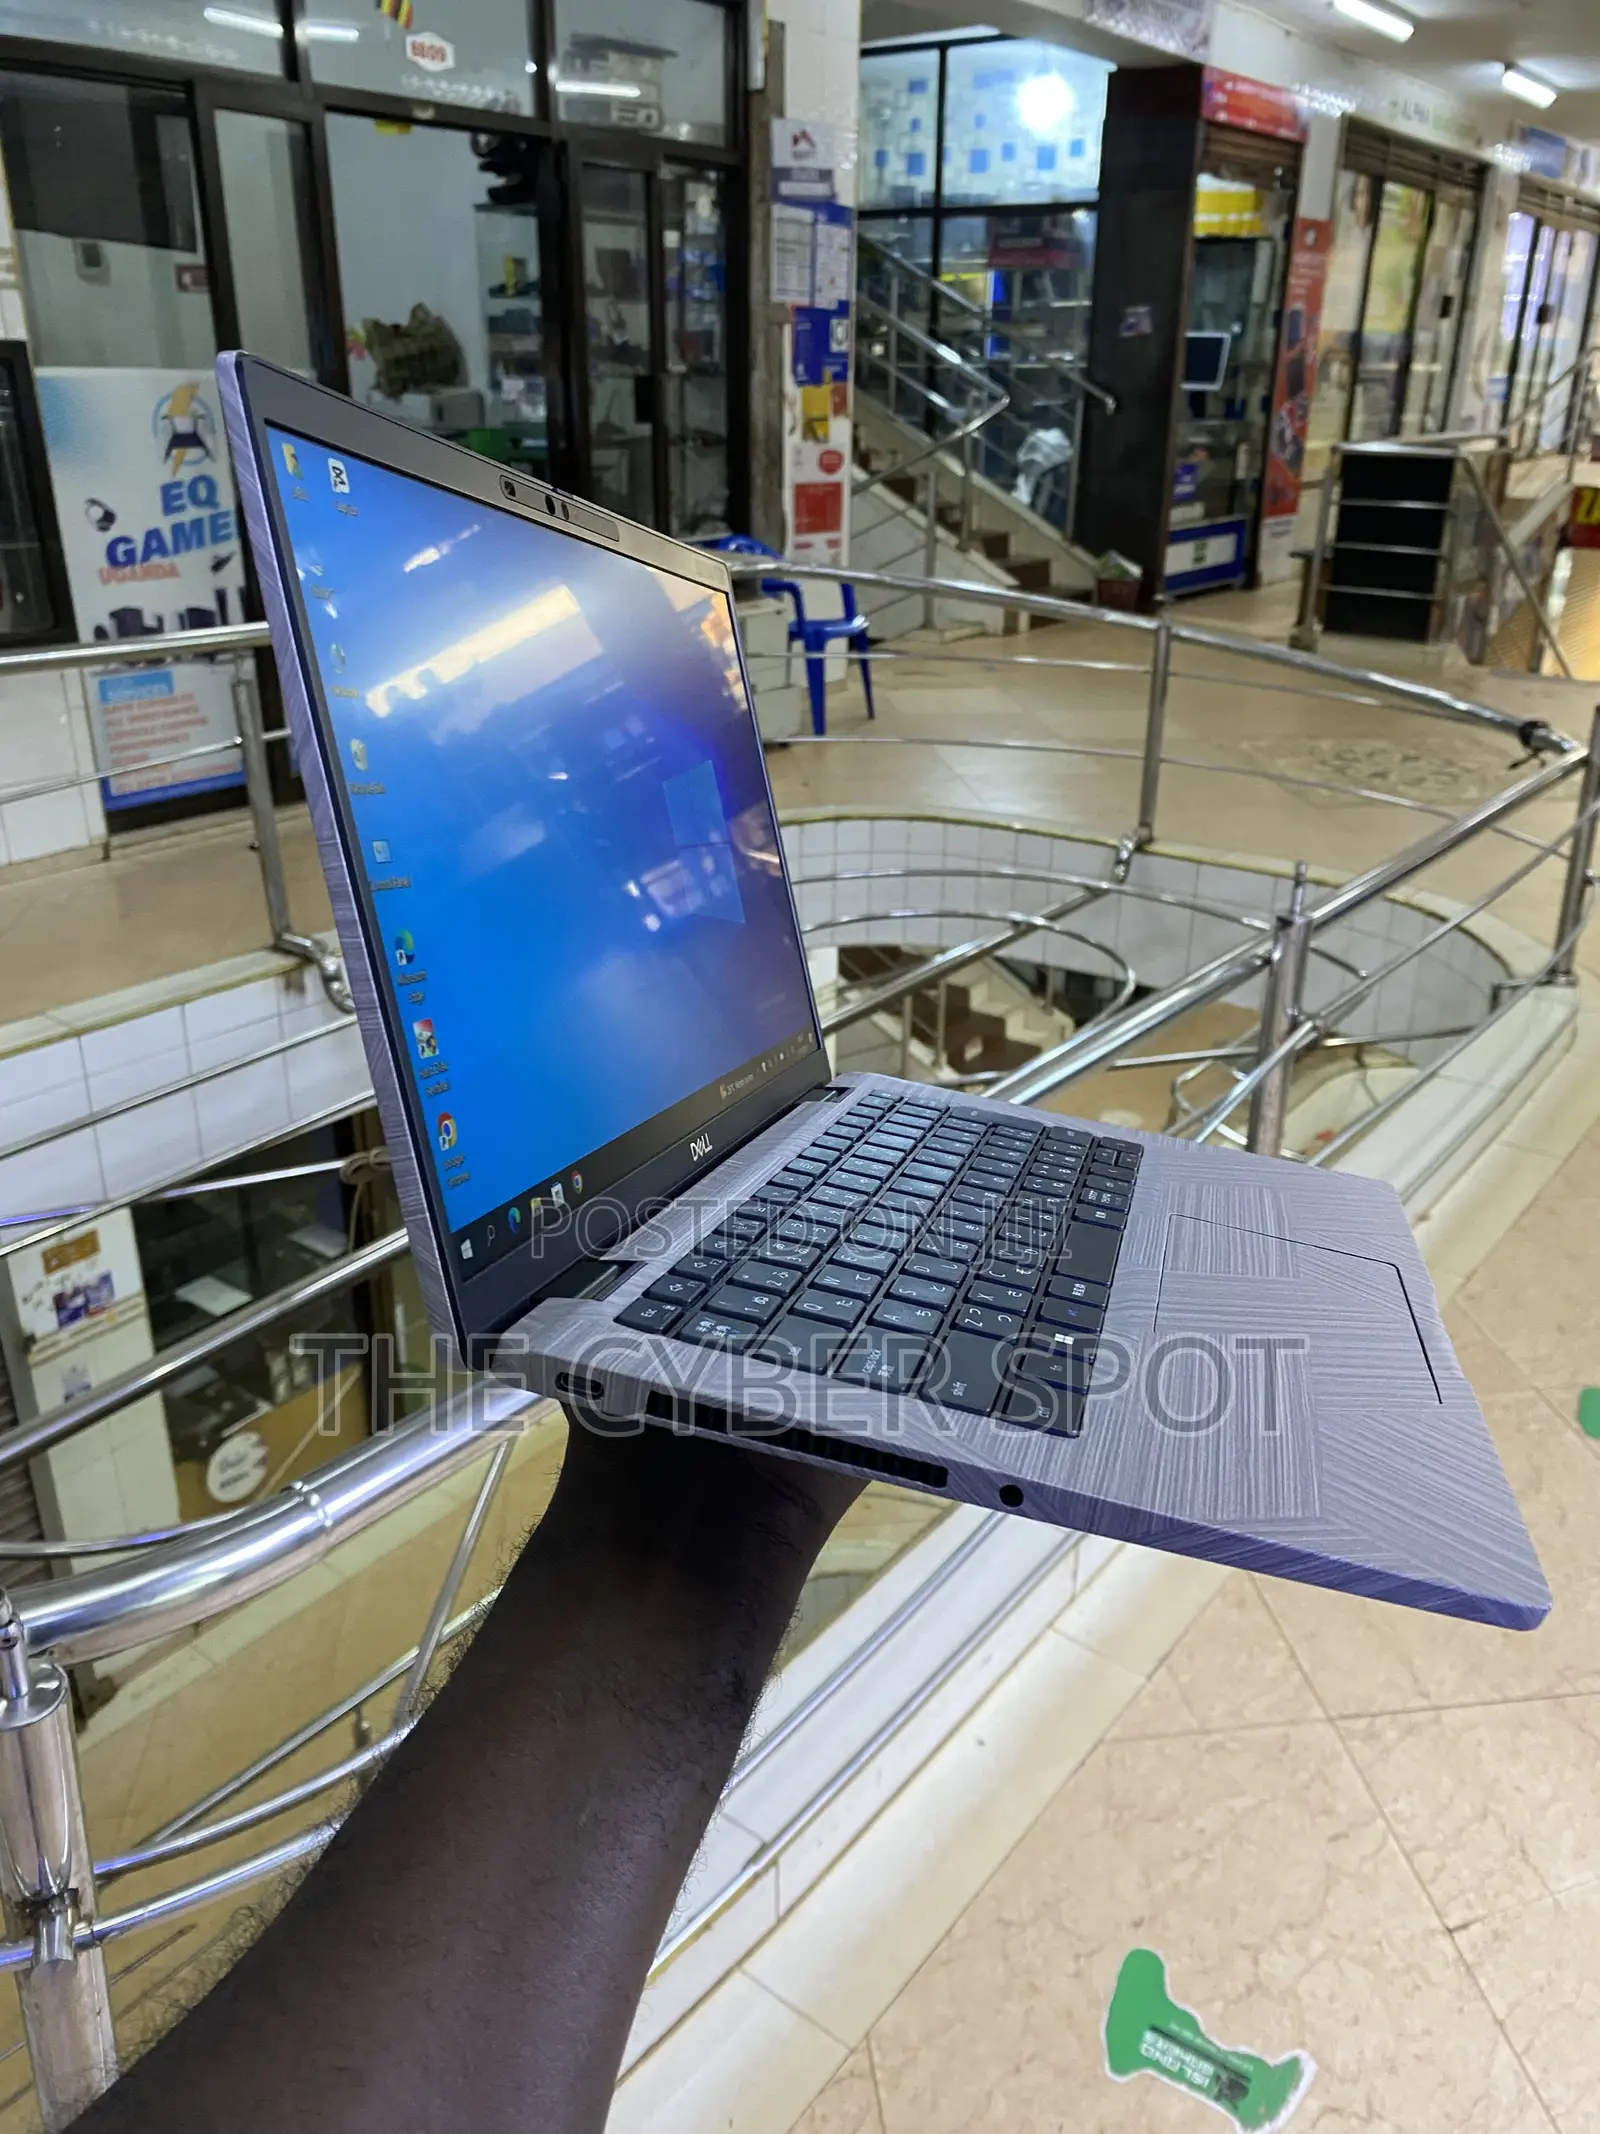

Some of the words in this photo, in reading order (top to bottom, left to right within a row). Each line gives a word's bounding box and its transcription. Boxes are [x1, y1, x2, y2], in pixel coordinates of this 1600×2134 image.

[160, 474, 220, 517] EQ
[105, 510, 233, 569] GAME
[689, 1133, 713, 1161] DELL
[989, 1270, 1006, 1278] C
[822, 1276, 840, 1285] W
[899, 1288, 916, 1296] S
[977, 1293, 994, 1301] X
[640, 1308, 657, 1317] Esc
[884, 1314, 901, 1322] A
[964, 1318, 983, 1327] Z
